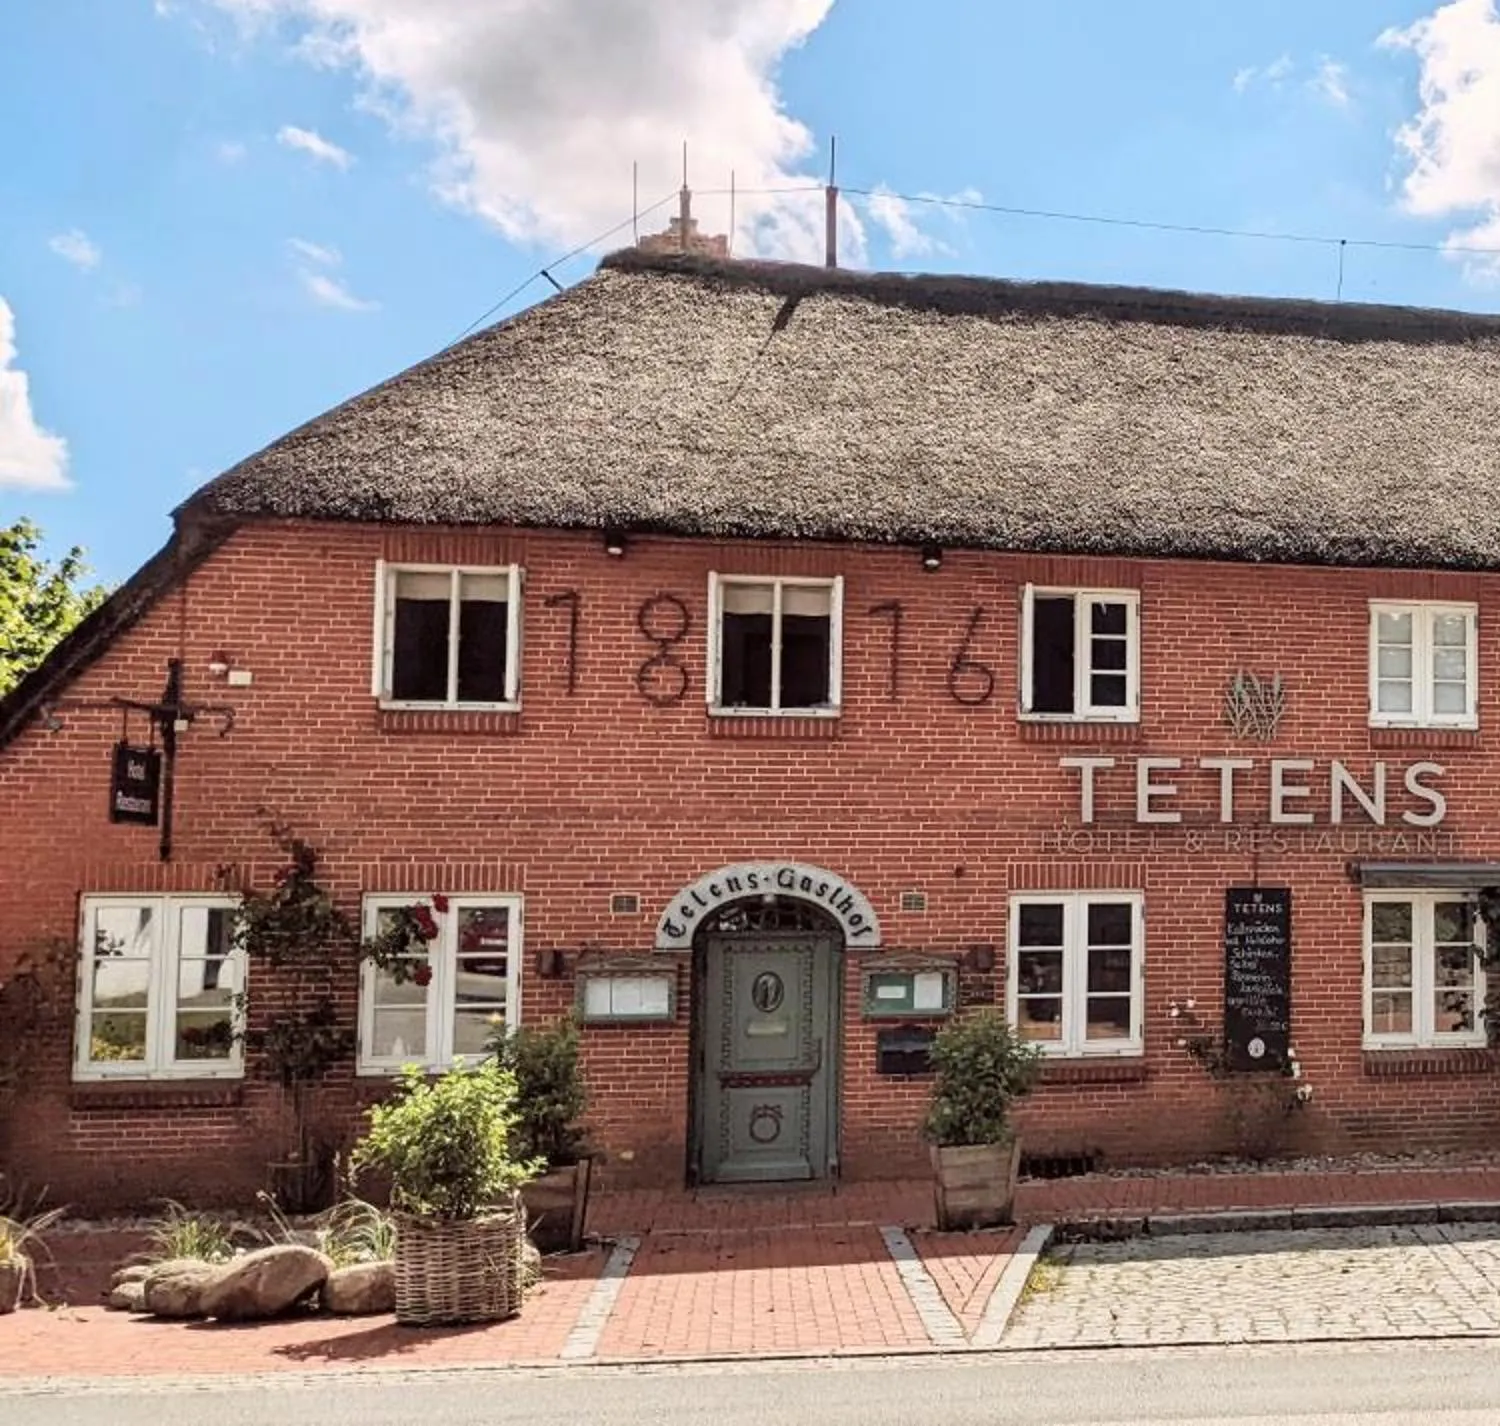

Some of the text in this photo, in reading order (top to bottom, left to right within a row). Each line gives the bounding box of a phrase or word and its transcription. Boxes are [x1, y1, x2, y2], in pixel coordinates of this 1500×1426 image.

[1059, 757, 1447, 827] TETENS
[1040, 829, 1460, 855] HOTEL & RESTAURANT
[1234, 903, 1283, 914] TETENS
